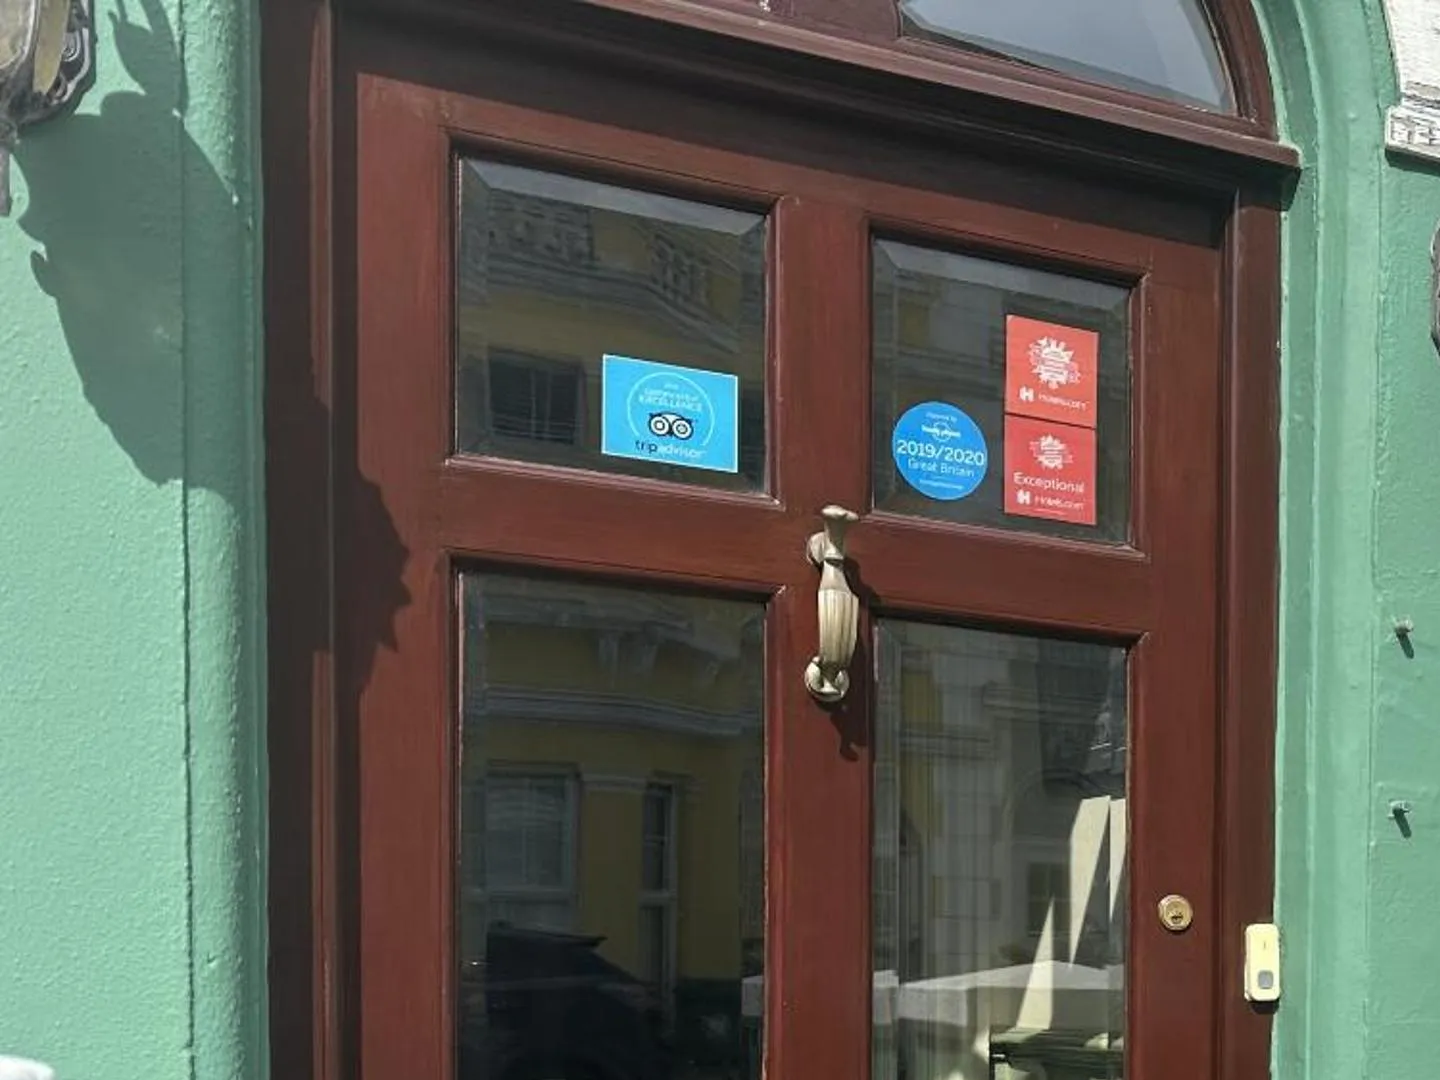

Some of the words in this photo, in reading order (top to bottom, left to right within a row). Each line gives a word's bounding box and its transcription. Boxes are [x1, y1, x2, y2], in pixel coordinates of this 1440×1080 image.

[896, 439, 985, 466] 2019/2020
[908, 458, 937, 472] Great
[941, 463, 974, 477] Britain
[1013, 471, 1085, 494] Exceptional
